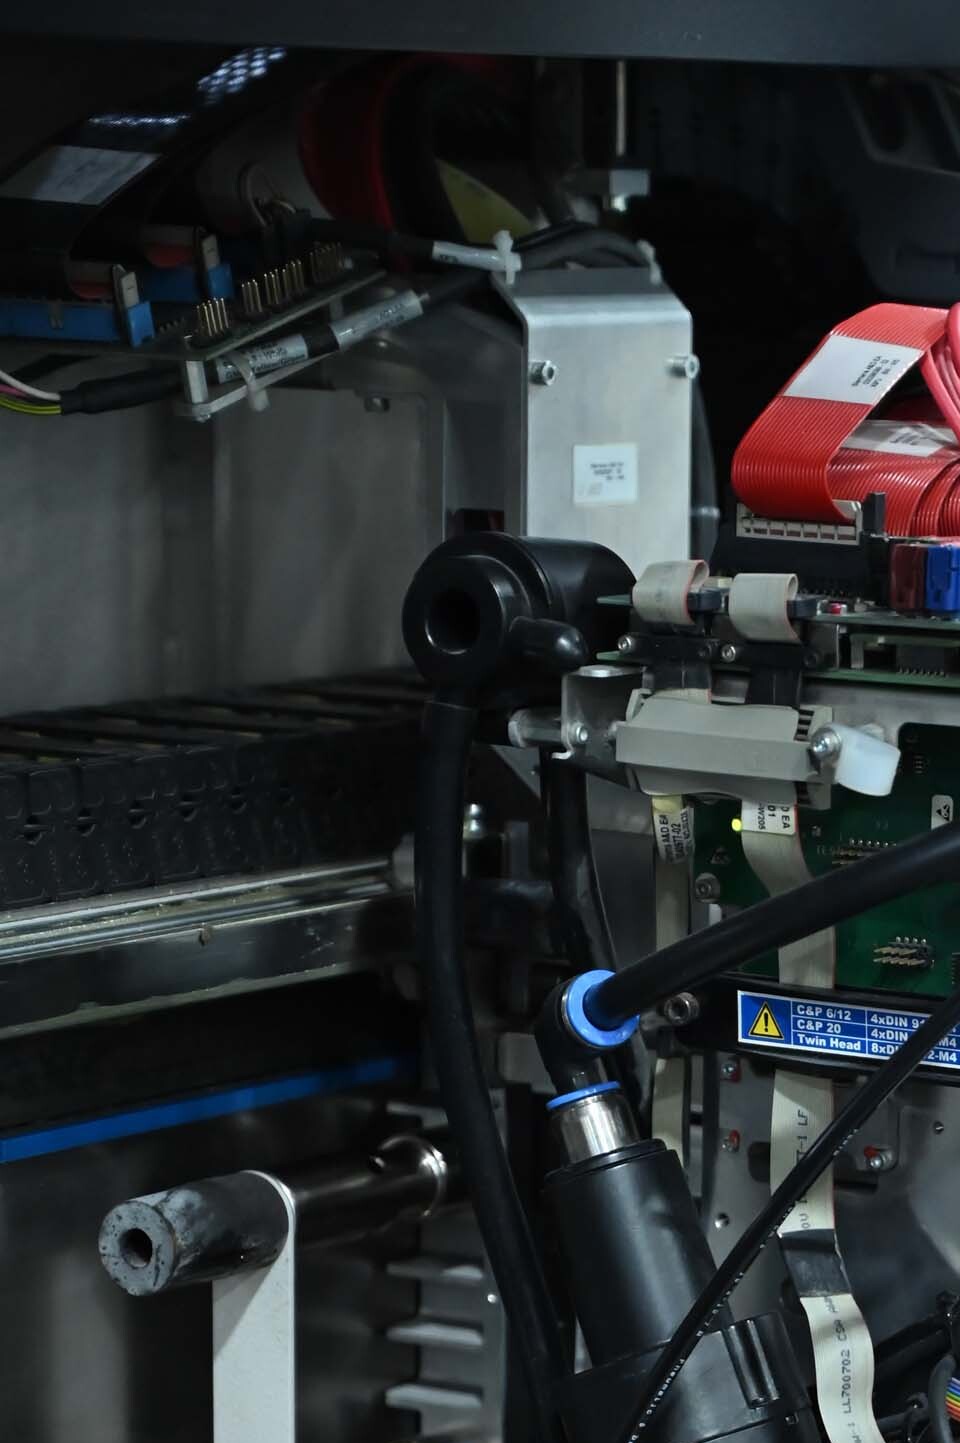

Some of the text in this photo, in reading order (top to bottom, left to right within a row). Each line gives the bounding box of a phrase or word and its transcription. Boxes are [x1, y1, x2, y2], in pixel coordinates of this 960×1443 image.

[797, 1005, 851, 1020] C&P 6/12
[797, 1019, 841, 1034] C&P 20
[870, 1014, 908, 1027] 4xDIN
[797, 1033, 861, 1051] Twin Head
[870, 1028, 909, 1042] 4xDIN
